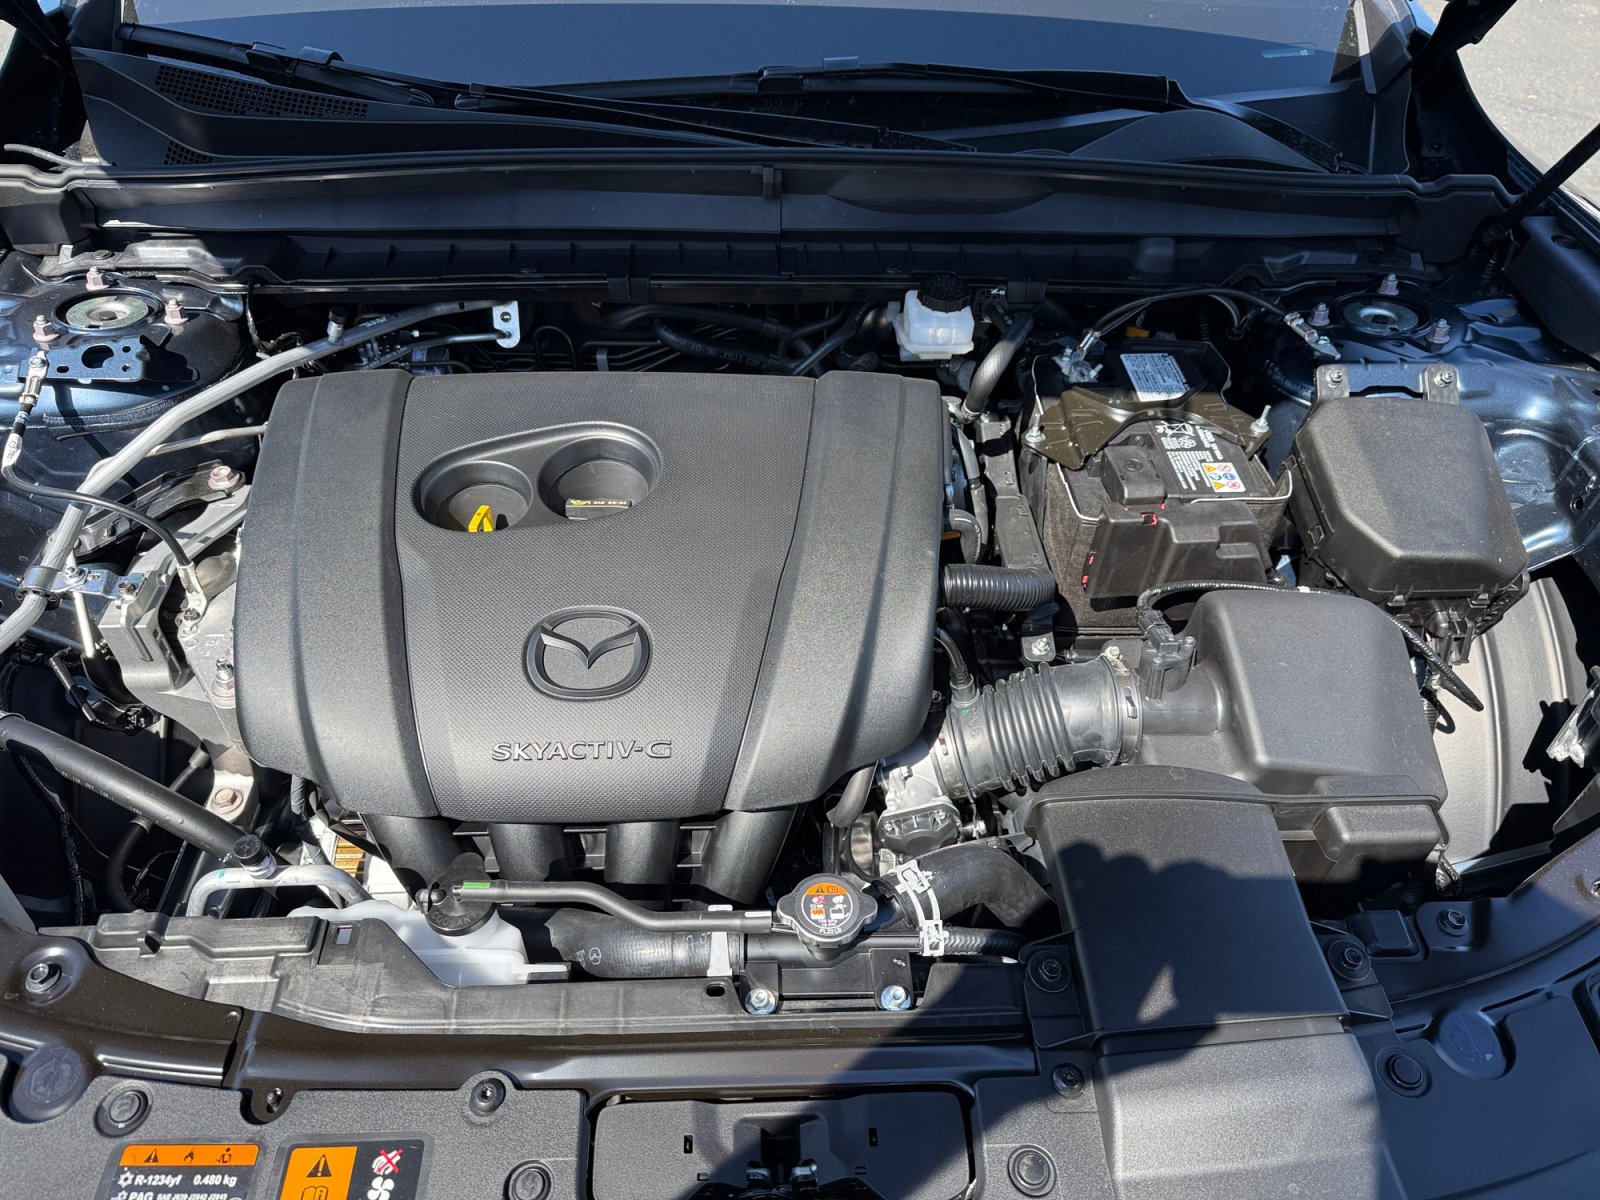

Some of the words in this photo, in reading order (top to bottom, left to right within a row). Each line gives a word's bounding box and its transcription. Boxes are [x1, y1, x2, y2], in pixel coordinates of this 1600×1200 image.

[492, 740, 672, 761] SKYACTIV-G
[134, 1174, 183, 1188] R-1234yf
[193, 1174, 221, 1186] 0.480
[223, 1174, 238, 1188] kg
[128, 1191, 154, 1200] PAG
